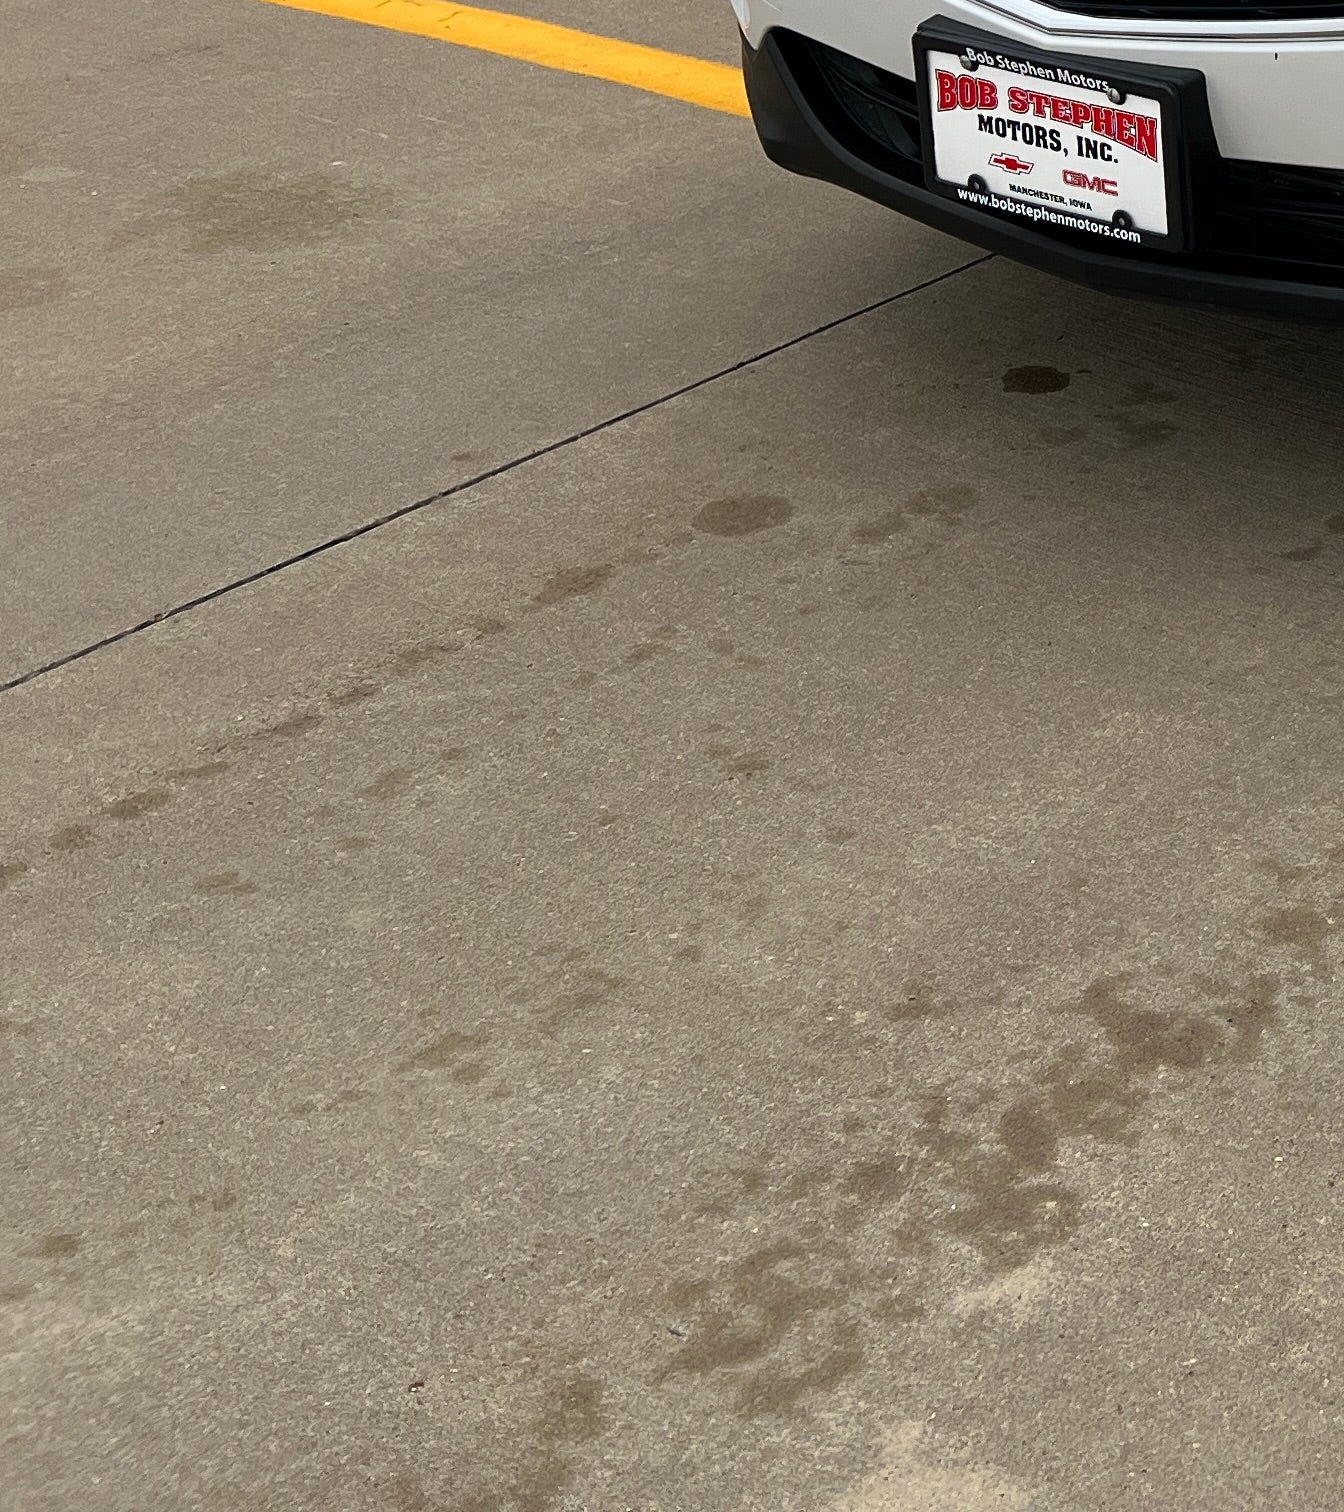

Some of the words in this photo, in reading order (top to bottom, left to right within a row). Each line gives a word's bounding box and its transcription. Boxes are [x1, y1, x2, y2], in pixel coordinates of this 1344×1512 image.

[965, 47, 995, 67] Bob
[996, 55, 1055, 79] Stephen
[1058, 67, 1110, 91] Motors
[935, 69, 998, 112] BOB
[1008, 86, 1158, 163] STEPHEN
[977, 114, 1069, 157] MOTORS,
[1077, 135, 1119, 164] INC.
[1009, 183, 1067, 206] MANCHESTER,
[1069, 198, 1093, 211] IOWA
[1062, 169, 1119, 197] GMC
[957, 188, 1141, 243] www.bobstephenmotors.com
